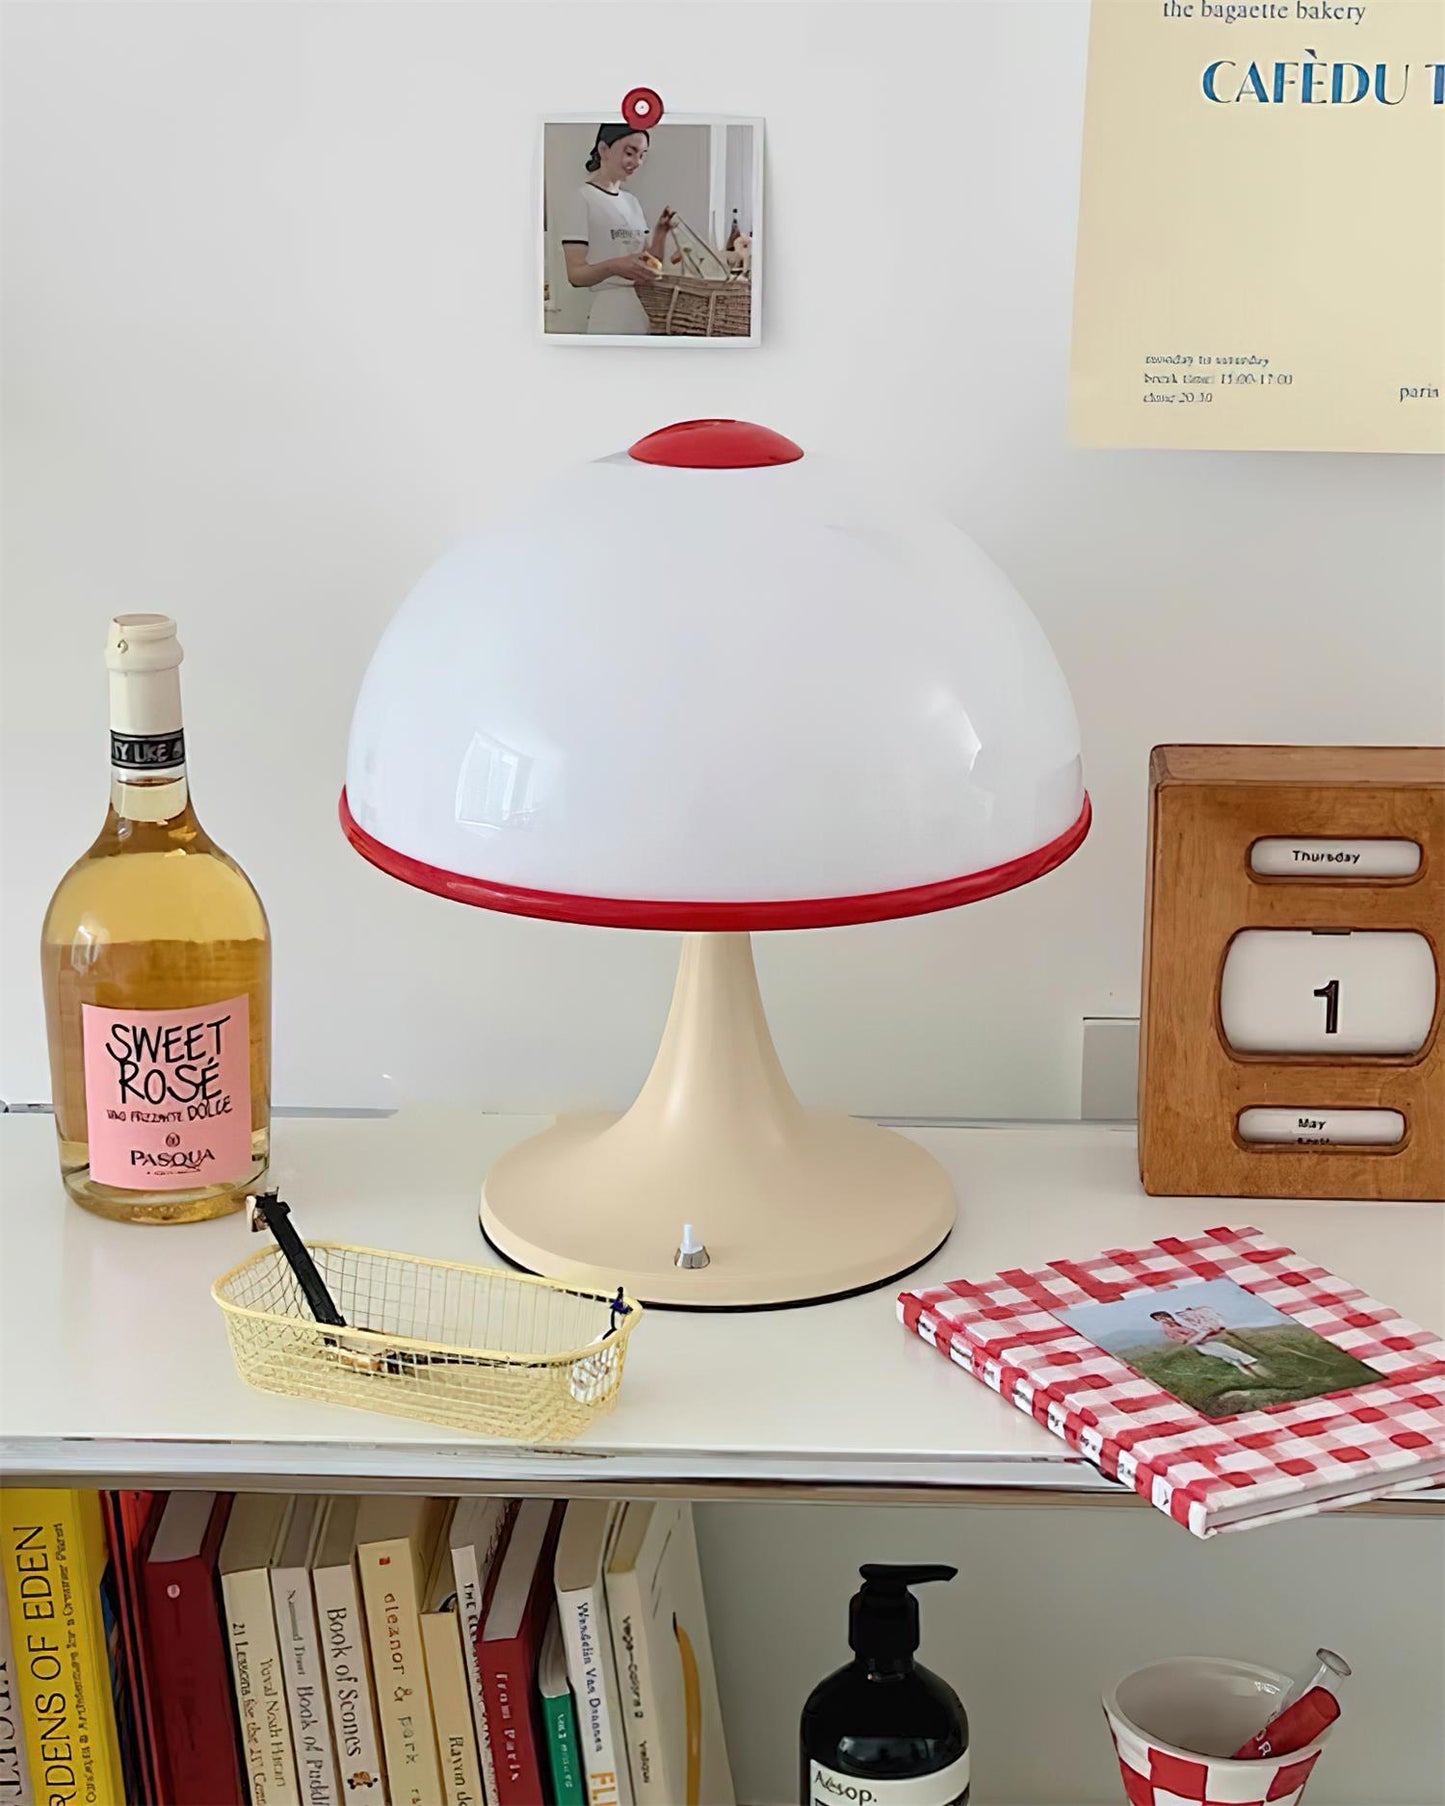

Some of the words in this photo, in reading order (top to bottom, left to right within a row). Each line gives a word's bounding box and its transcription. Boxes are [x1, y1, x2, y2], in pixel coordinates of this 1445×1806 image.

[1163, 0, 1194, 18] the
[1296, 1, 1367, 26] bakery
[1202, 48, 1410, 106] CAFÈDU
[1291, 849, 1361, 865] Thursday
[1313, 979, 1340, 1034] 1
[105, 1014, 232, 1064] SWEET
[118, 1056, 223, 1105] ROSÉ
[1297, 1117, 1328, 1131] May
[130, 1148, 217, 1173] PASQUA
[12, 1525, 57, 1621] EDEN
[326, 1607, 353, 1658] Book
[27, 1634, 63, 1682] OF
[335, 1663, 359, 1683] of
[296, 1685, 320, 1731] Book
[338, 1688, 363, 1758] Scones
